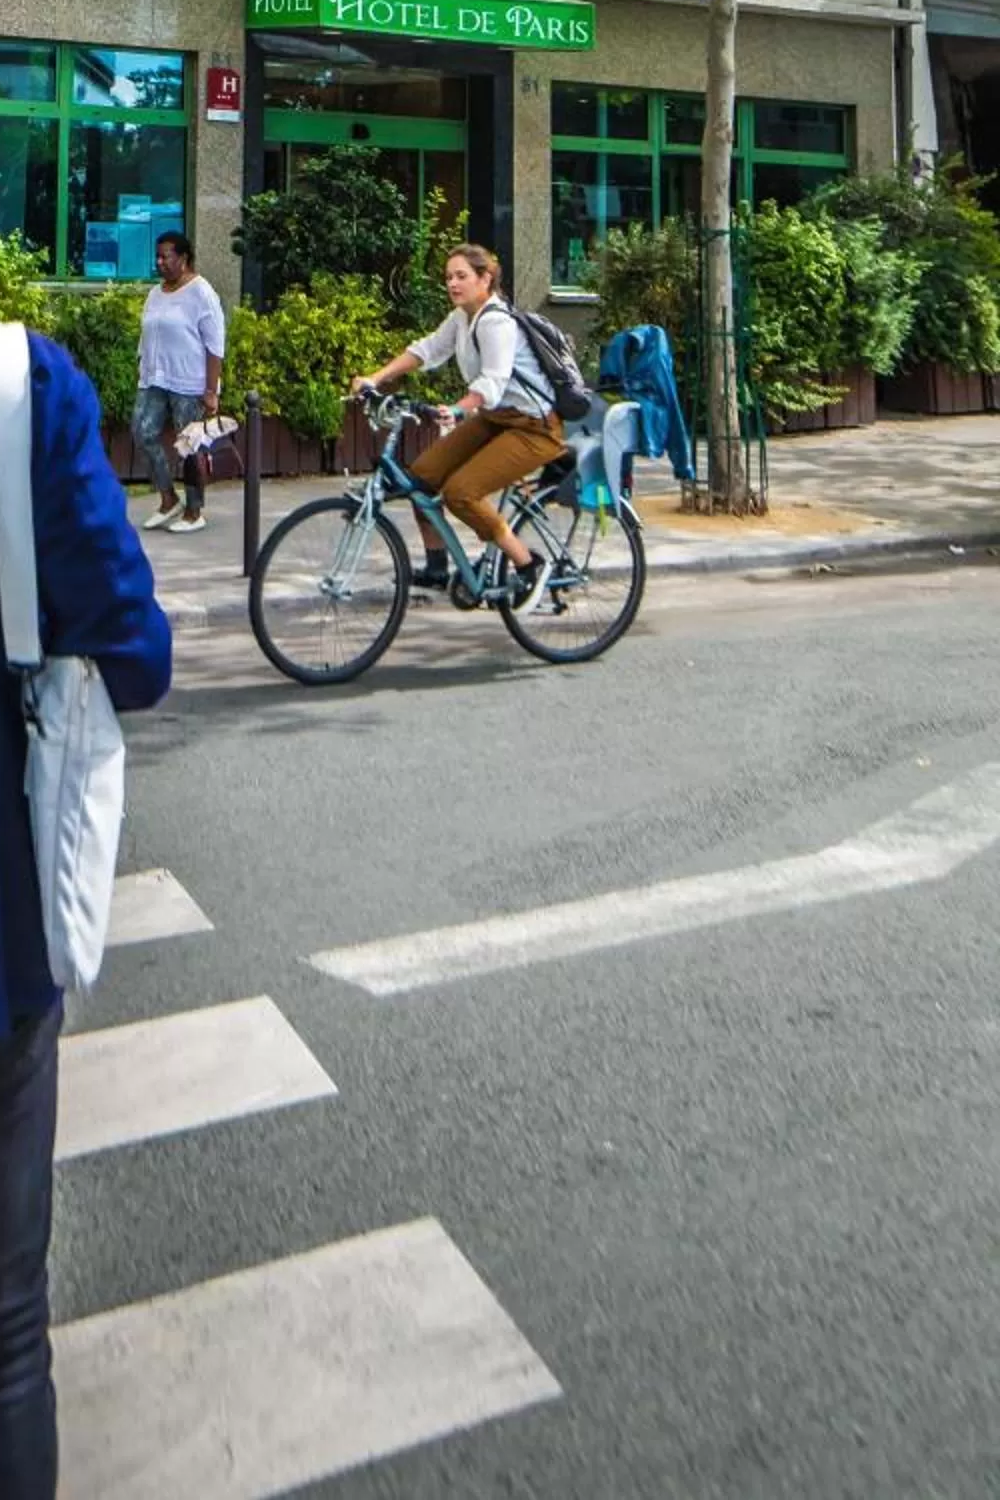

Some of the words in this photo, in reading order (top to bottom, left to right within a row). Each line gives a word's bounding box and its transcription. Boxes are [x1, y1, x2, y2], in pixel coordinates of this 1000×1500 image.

[458, 8, 497, 35] DE
[505, 5, 589, 44] PARIS
[222, 76, 238, 93] H
